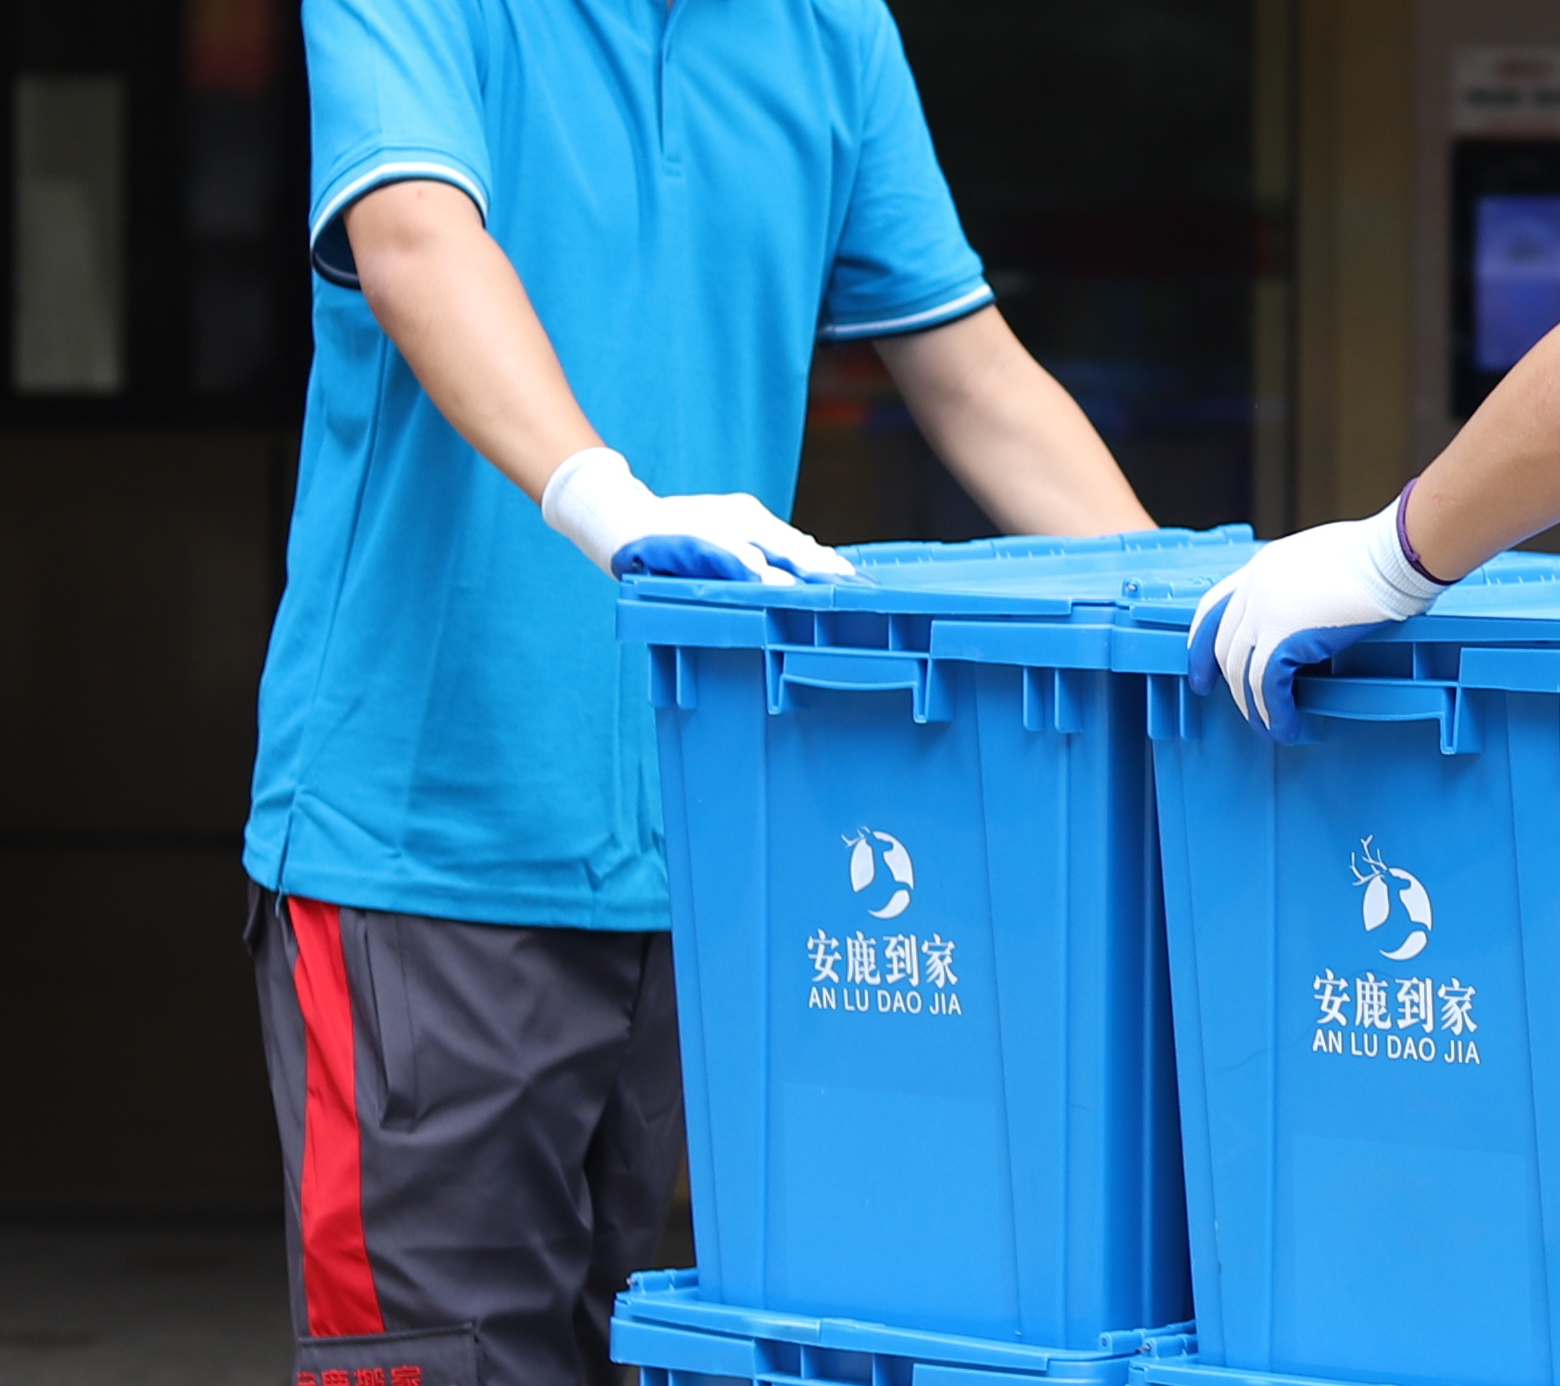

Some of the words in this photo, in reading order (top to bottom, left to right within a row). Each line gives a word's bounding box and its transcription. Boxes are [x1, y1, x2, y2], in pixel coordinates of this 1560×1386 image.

[806, 928, 959, 990] 安鹿到家
[808, 986, 836, 1010] AN
[843, 988, 869, 1012] LU
[877, 989, 922, 1014] DAO
[929, 992, 962, 1016] JIA
[1312, 967, 1479, 1037] 安鹿到家
[1312, 1028, 1343, 1054] AN
[1351, 1032, 1378, 1057] LU
[1387, 1035, 1436, 1062] DAO
[1444, 1040, 1480, 1065] JIA
